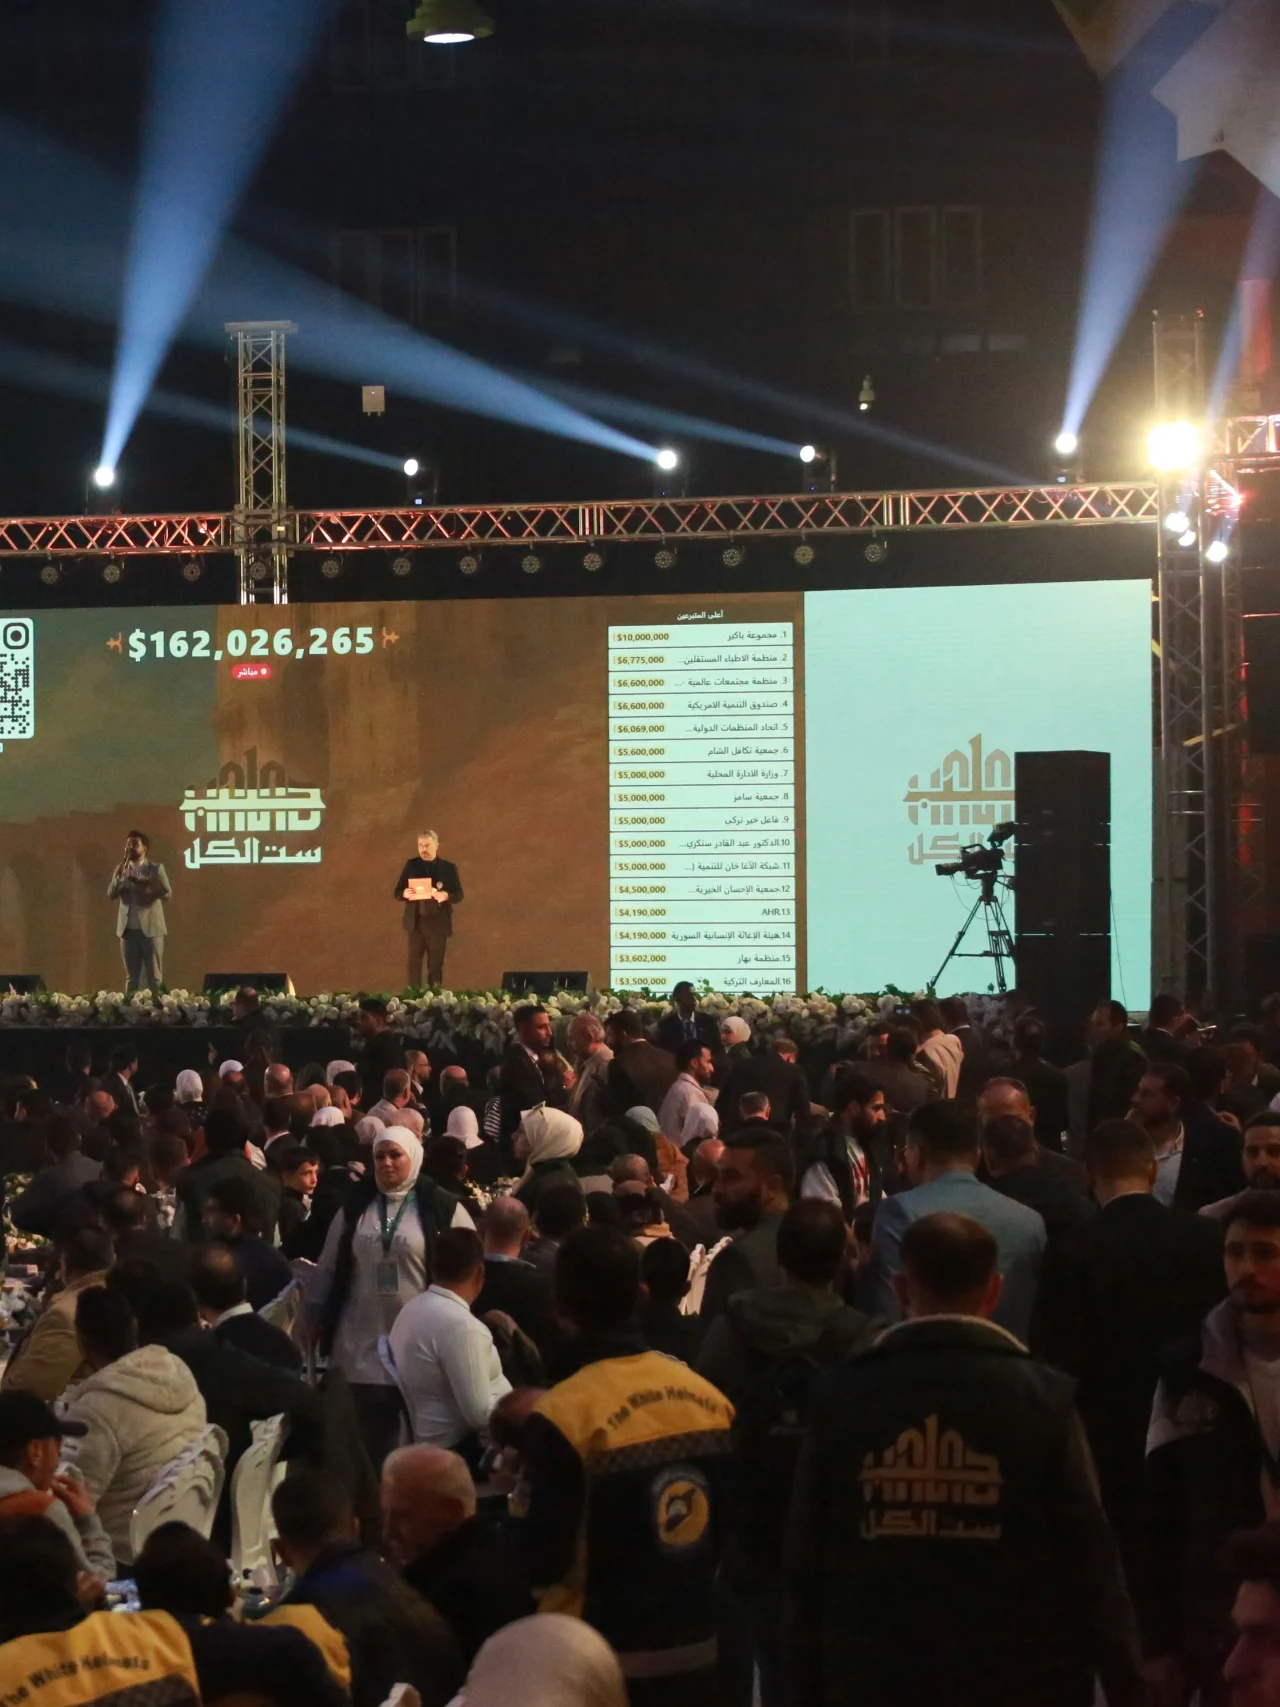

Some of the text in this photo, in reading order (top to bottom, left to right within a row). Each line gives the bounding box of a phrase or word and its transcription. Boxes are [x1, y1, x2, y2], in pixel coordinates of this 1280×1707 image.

[617, 633, 669, 642] $10,000,000
[129, 627, 373, 662] $162,026,265
[618, 656, 664, 664] $6,775,000
[237, 667, 258, 678] مباشر
[618, 679, 664, 687] $6,600,000
[618, 702, 664, 710] $6,600,000
[618, 725, 664, 733] $6,069,000
[184, 836, 322, 870] ست الكل
[619, 863, 665, 871] $5,000,000
[619, 886, 666, 894] $4,500,000
